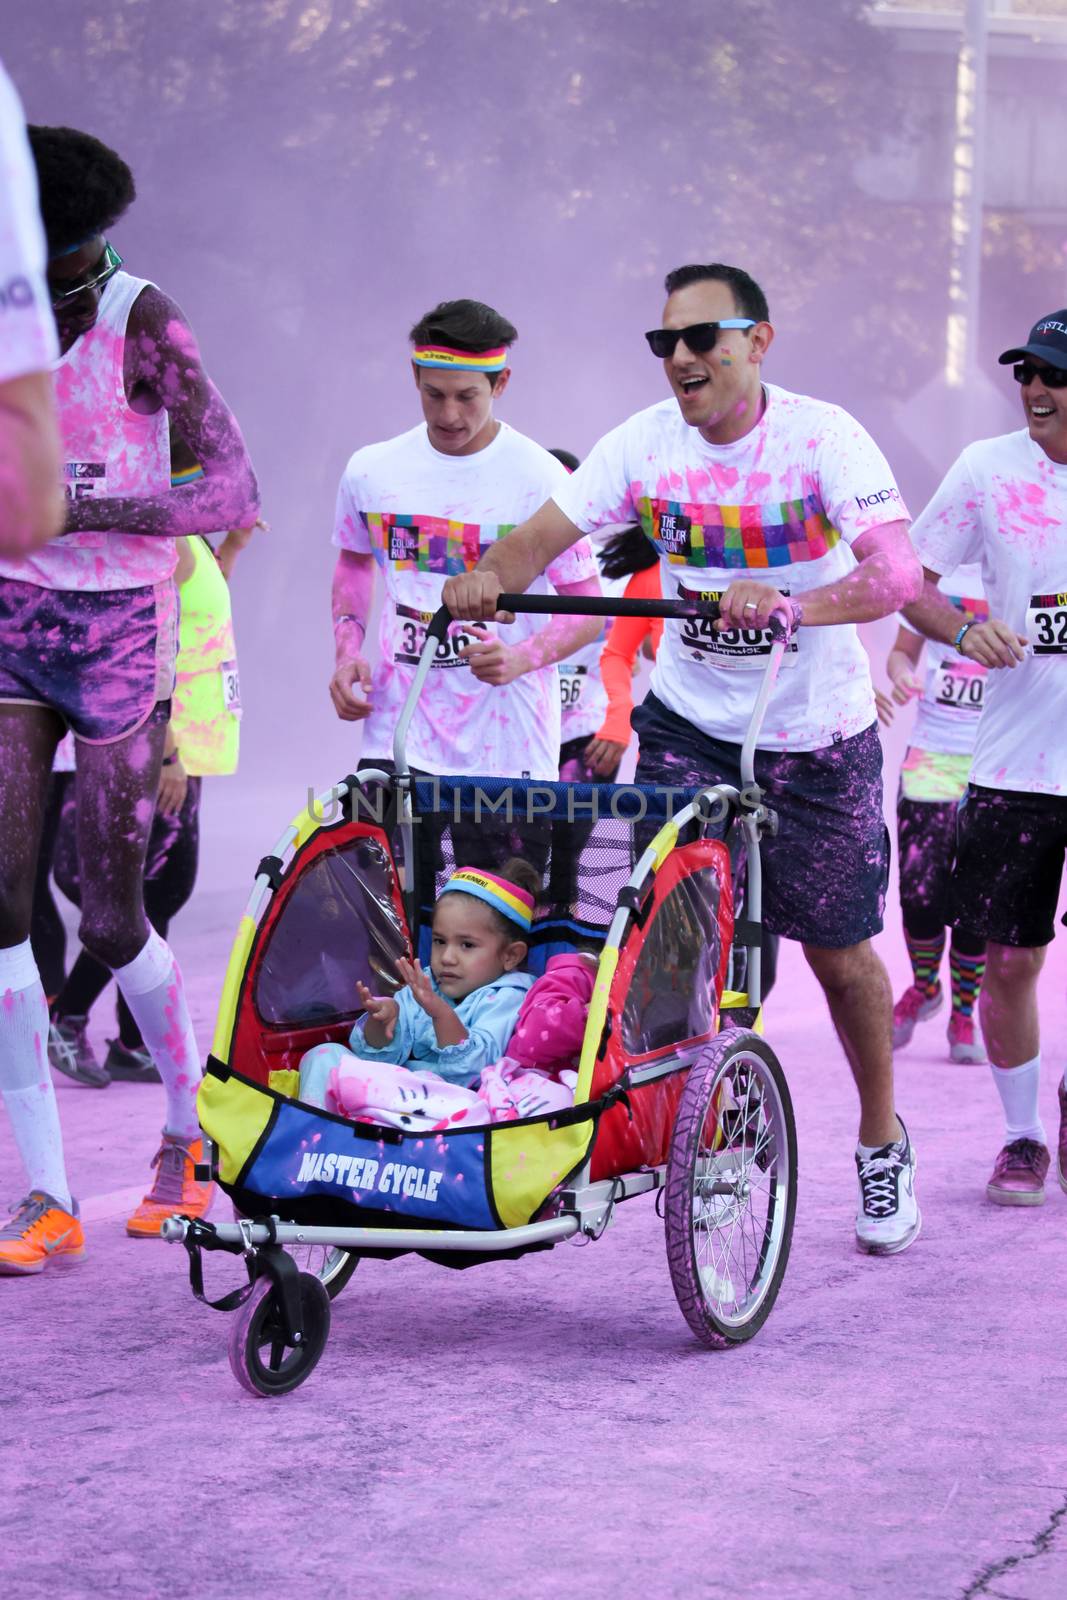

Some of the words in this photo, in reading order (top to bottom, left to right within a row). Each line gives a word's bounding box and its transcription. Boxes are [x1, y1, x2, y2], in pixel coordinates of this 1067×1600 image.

[661, 515, 677, 529] THE
[661, 527, 687, 544] COLOR
[378, 1162, 443, 1202] CYCLE
